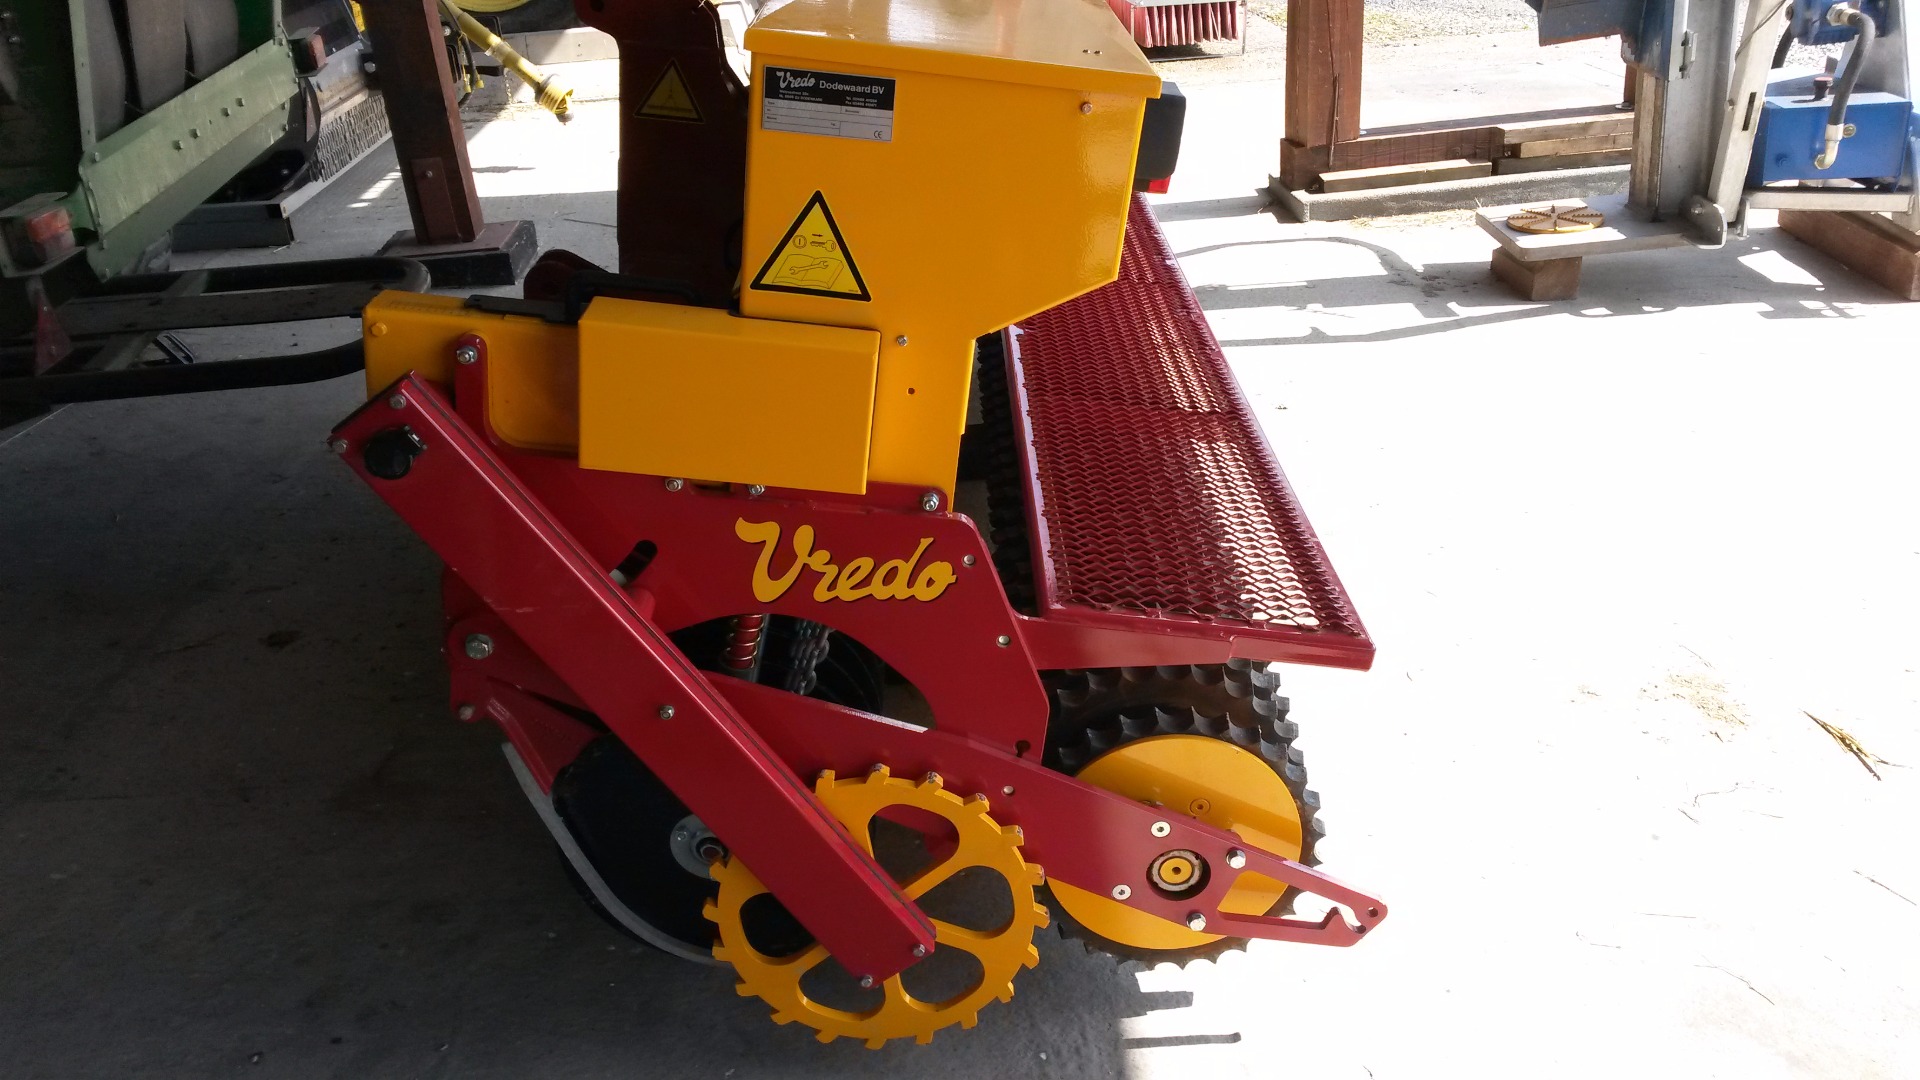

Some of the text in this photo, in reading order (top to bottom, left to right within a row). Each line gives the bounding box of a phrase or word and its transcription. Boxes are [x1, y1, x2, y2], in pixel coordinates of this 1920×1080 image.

[776, 71, 816, 89] Vredo
[819, 80, 871, 94] Dodewaard
[872, 85, 885, 95] BV
[873, 130, 883, 139] CE
[735, 517, 957, 602] Vredo
